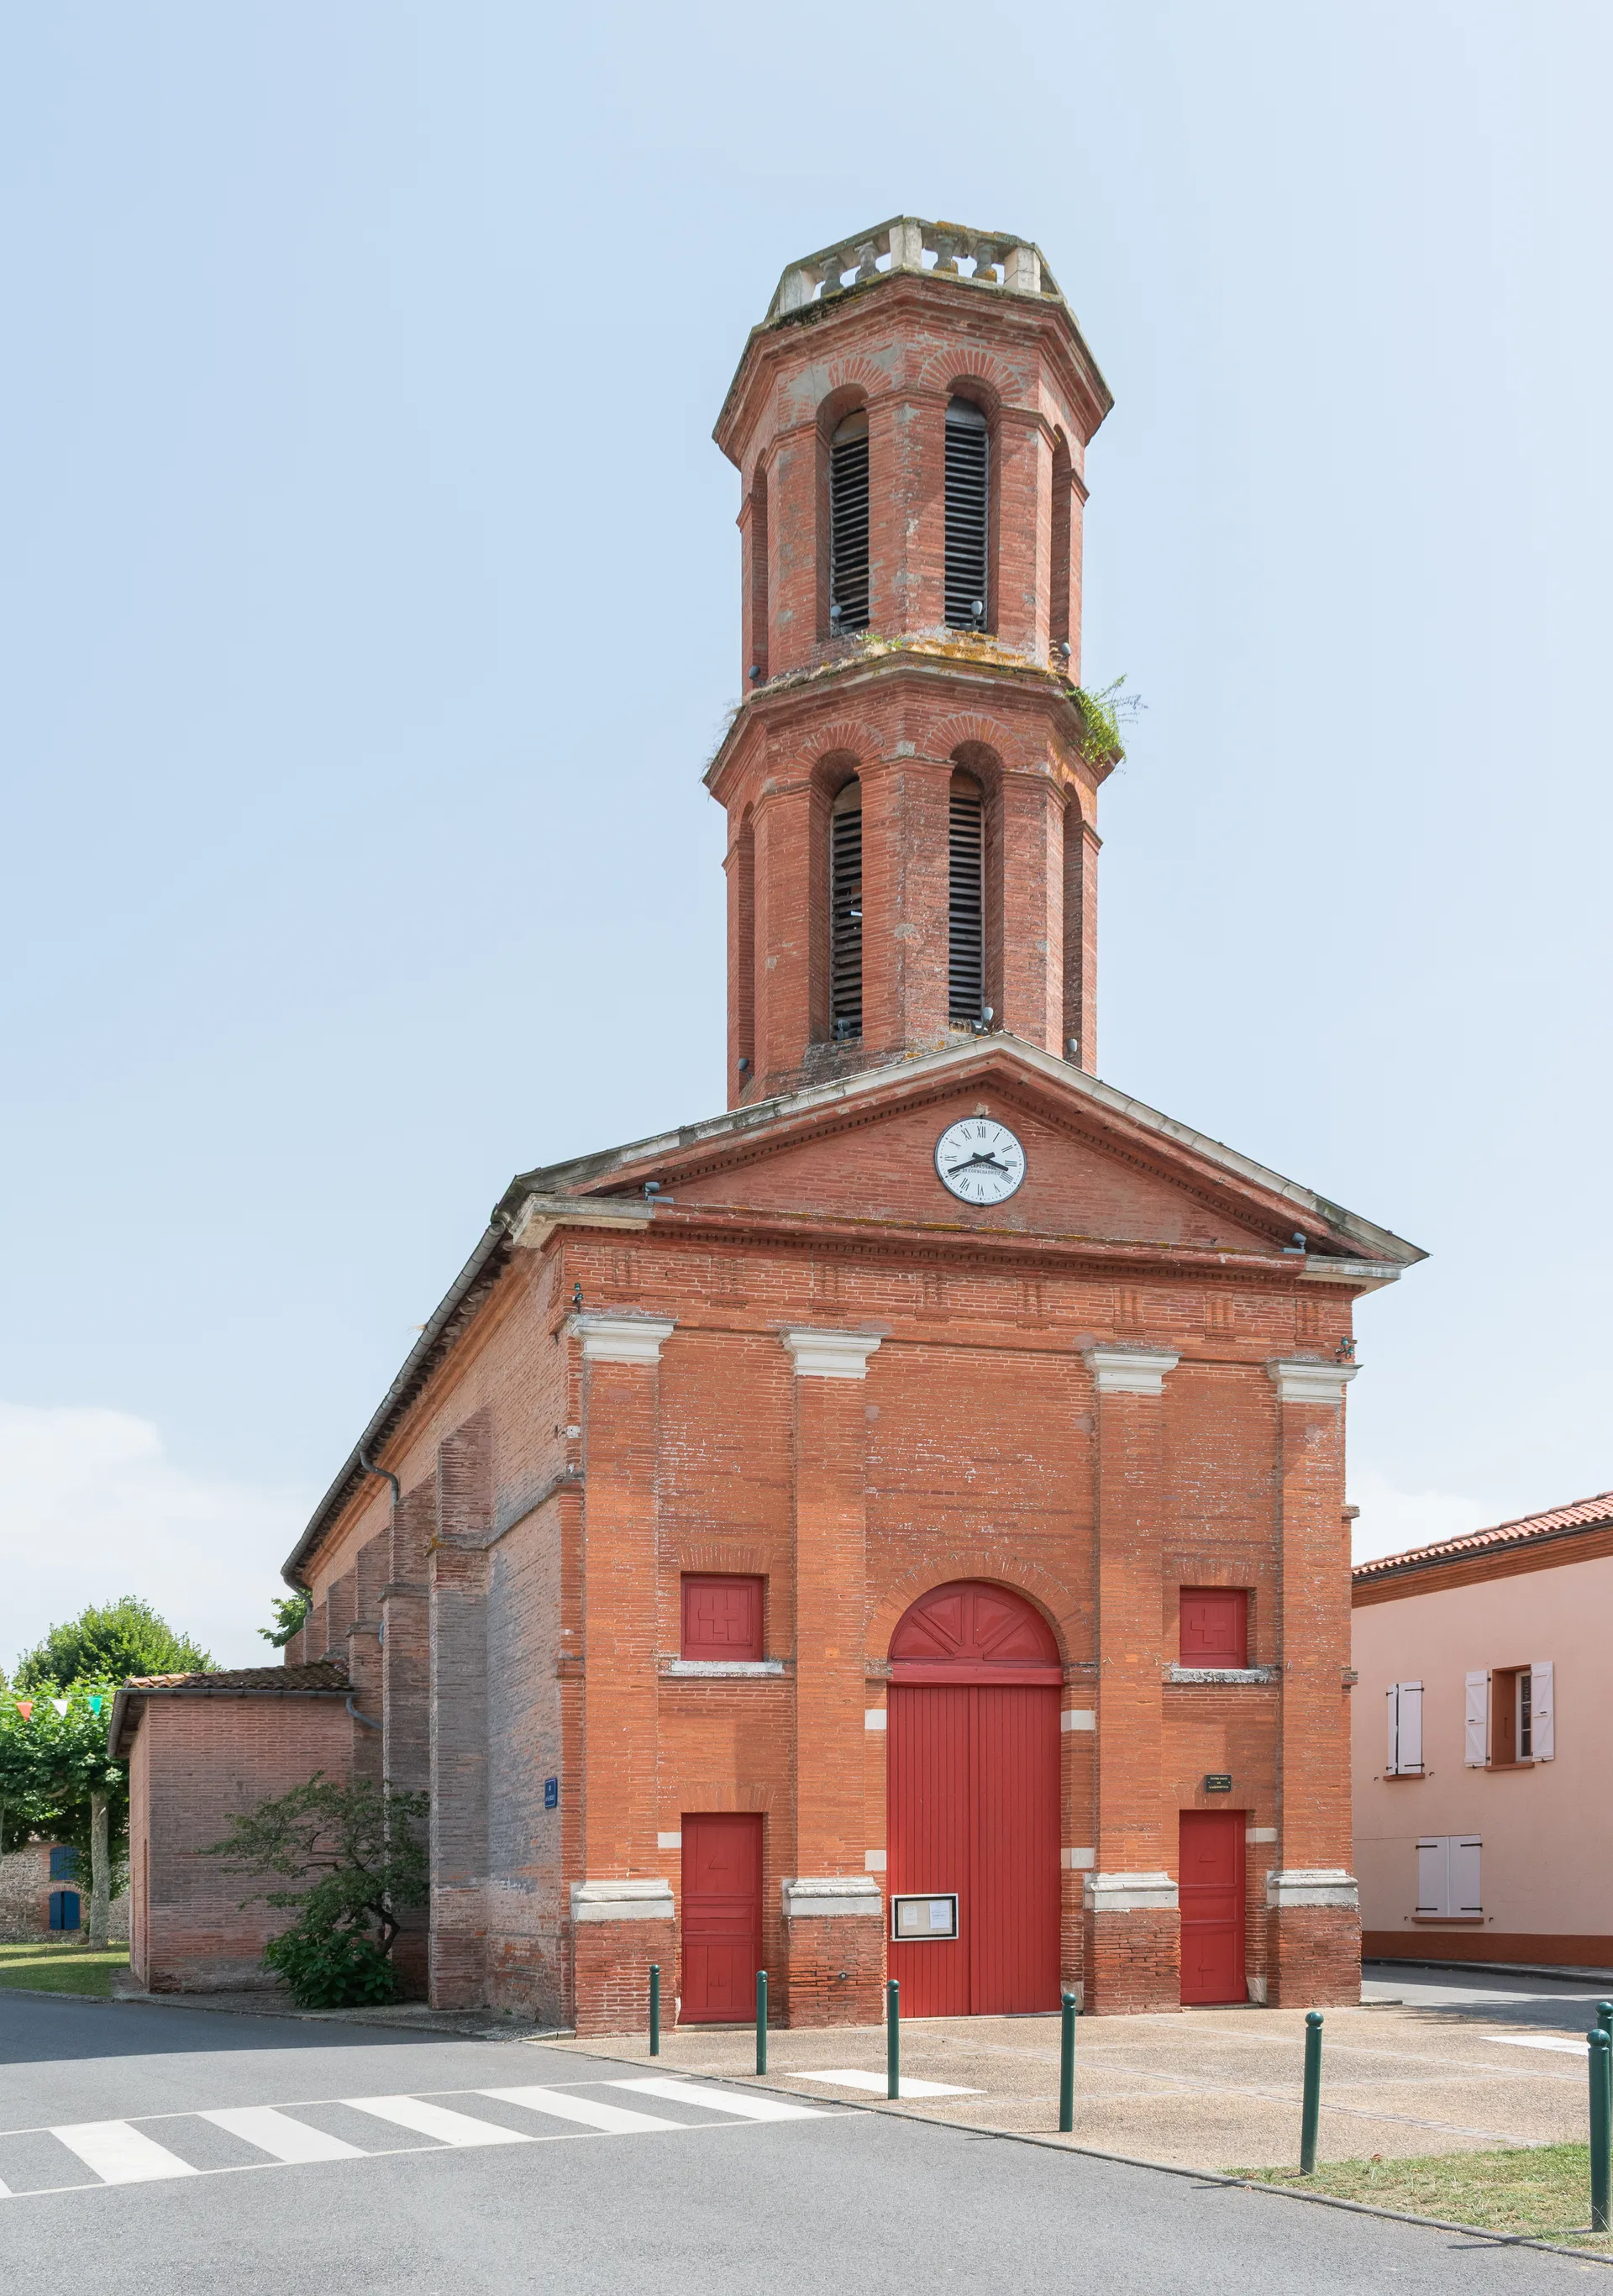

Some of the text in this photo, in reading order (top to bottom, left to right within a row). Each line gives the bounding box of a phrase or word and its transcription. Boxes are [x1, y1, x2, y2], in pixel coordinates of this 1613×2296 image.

[961, 1127, 972, 1141] XI
[977, 1126, 986, 1138] XII
[948, 1139, 961, 1149] X
[1001, 1144, 1013, 1153] II
